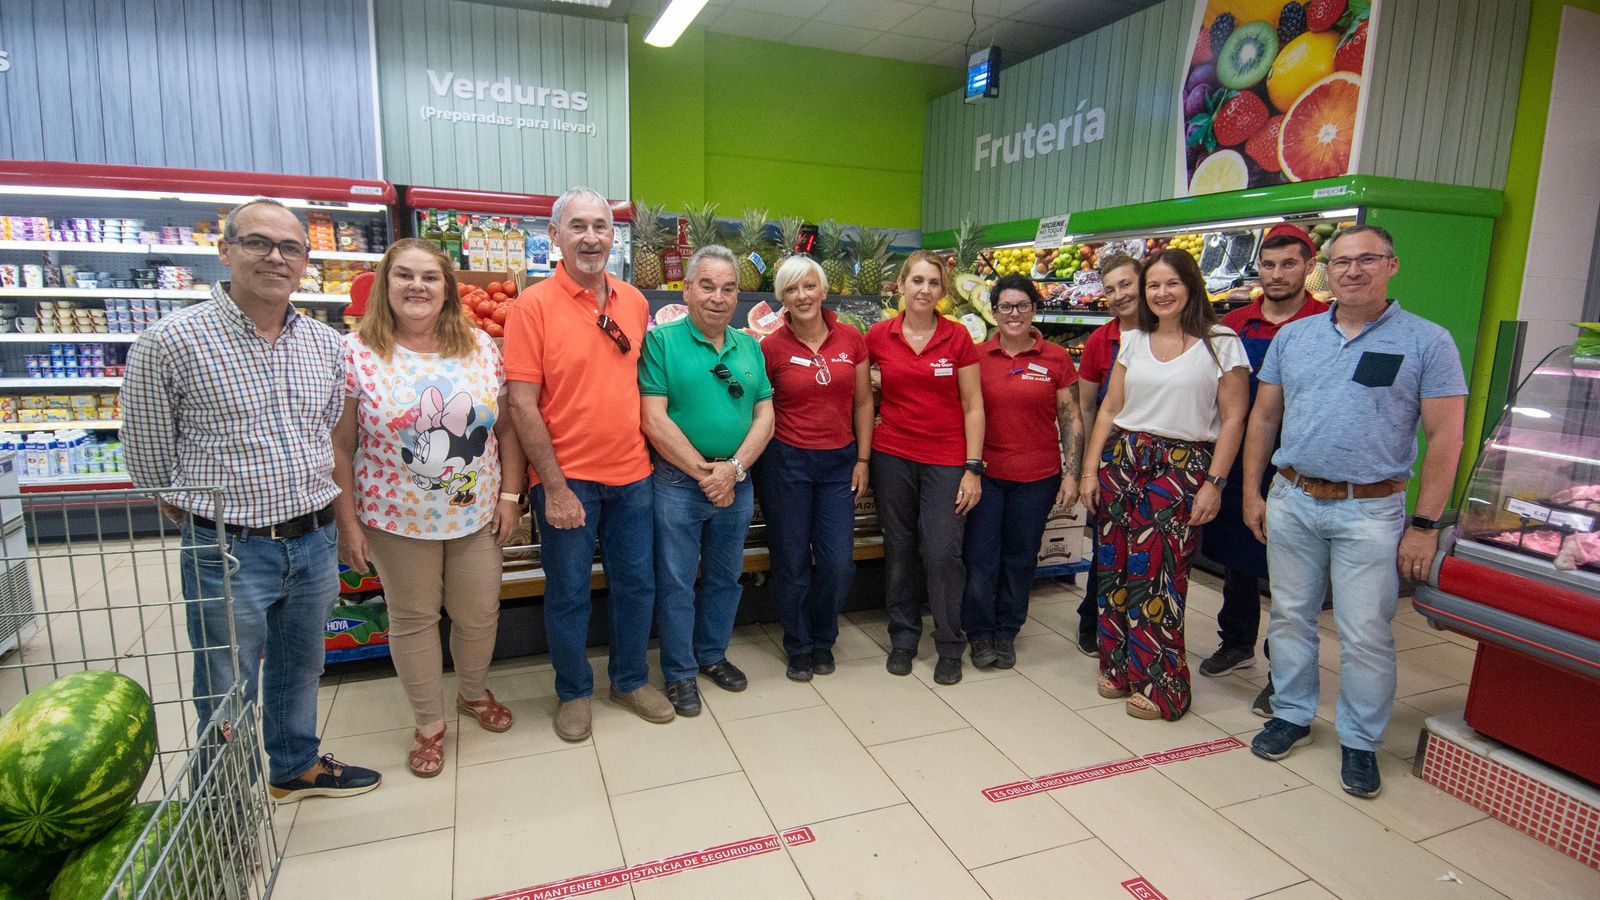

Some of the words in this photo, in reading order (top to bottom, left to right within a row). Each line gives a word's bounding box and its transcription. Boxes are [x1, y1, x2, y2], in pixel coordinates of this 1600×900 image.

[427, 69, 588, 112] Verduras
[420, 105, 513, 126] (Preparadas
[518, 117, 549, 131] para
[553, 119, 597, 137] llevar)
[975, 98, 1106, 172] Frutería
[1040, 219, 1066, 229] HIGIENE
[327, 619, 349, 631] HOYA
[1006, 779, 1062, 795] OBLIGATORIO
[1062, 769, 1107, 783] MANTENER
[1108, 766, 1118, 774] LA
[1117, 758, 1157, 771] DISTANCIA
[1168, 747, 1209, 760] SEGURIDAD
[534, 879, 601, 900] MANTENER
[604, 876, 620, 885] LA
[622, 862, 682, 881] DISTANCIA
[684, 858, 699, 867] DE
[701, 843, 763, 863] SEGURIDAD
[765, 833, 804, 850] MÍIMA
[1135, 887, 1151, 898] ES
